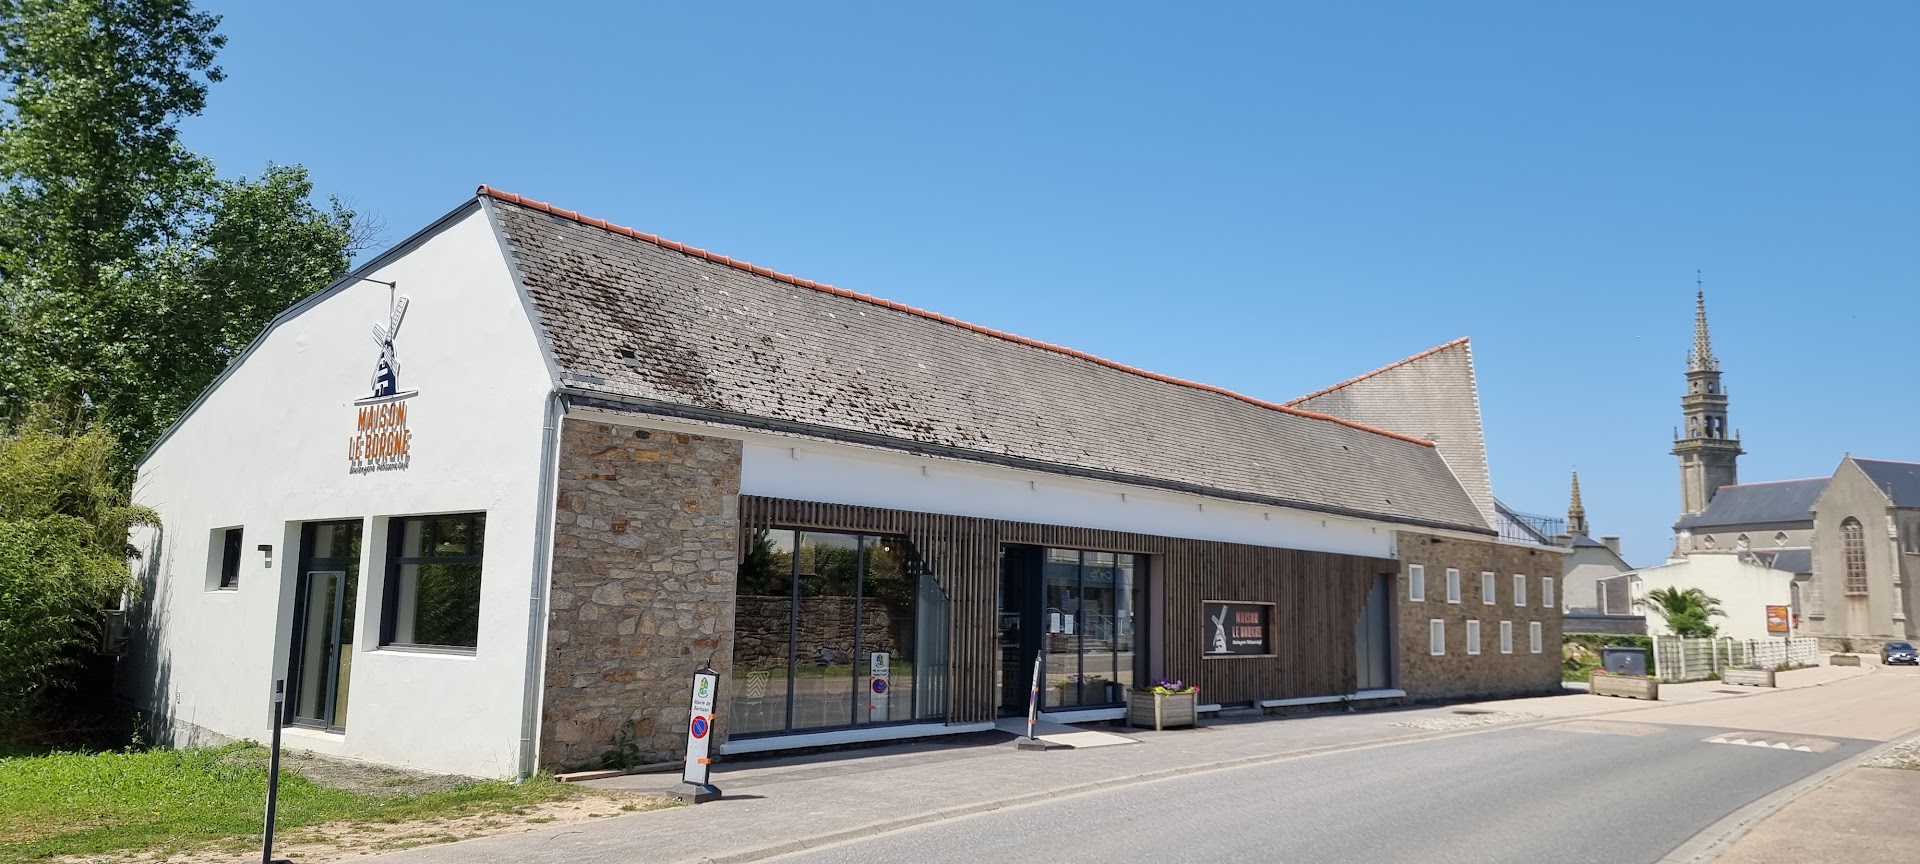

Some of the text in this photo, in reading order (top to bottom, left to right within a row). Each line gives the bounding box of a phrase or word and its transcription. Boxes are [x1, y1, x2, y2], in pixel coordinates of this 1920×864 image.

[358, 401, 405, 431] MAISON
[349, 429, 409, 460] LE BORGNE
[1235, 611, 1259, 624] MAISON
[1232, 625, 1240, 638] LE
